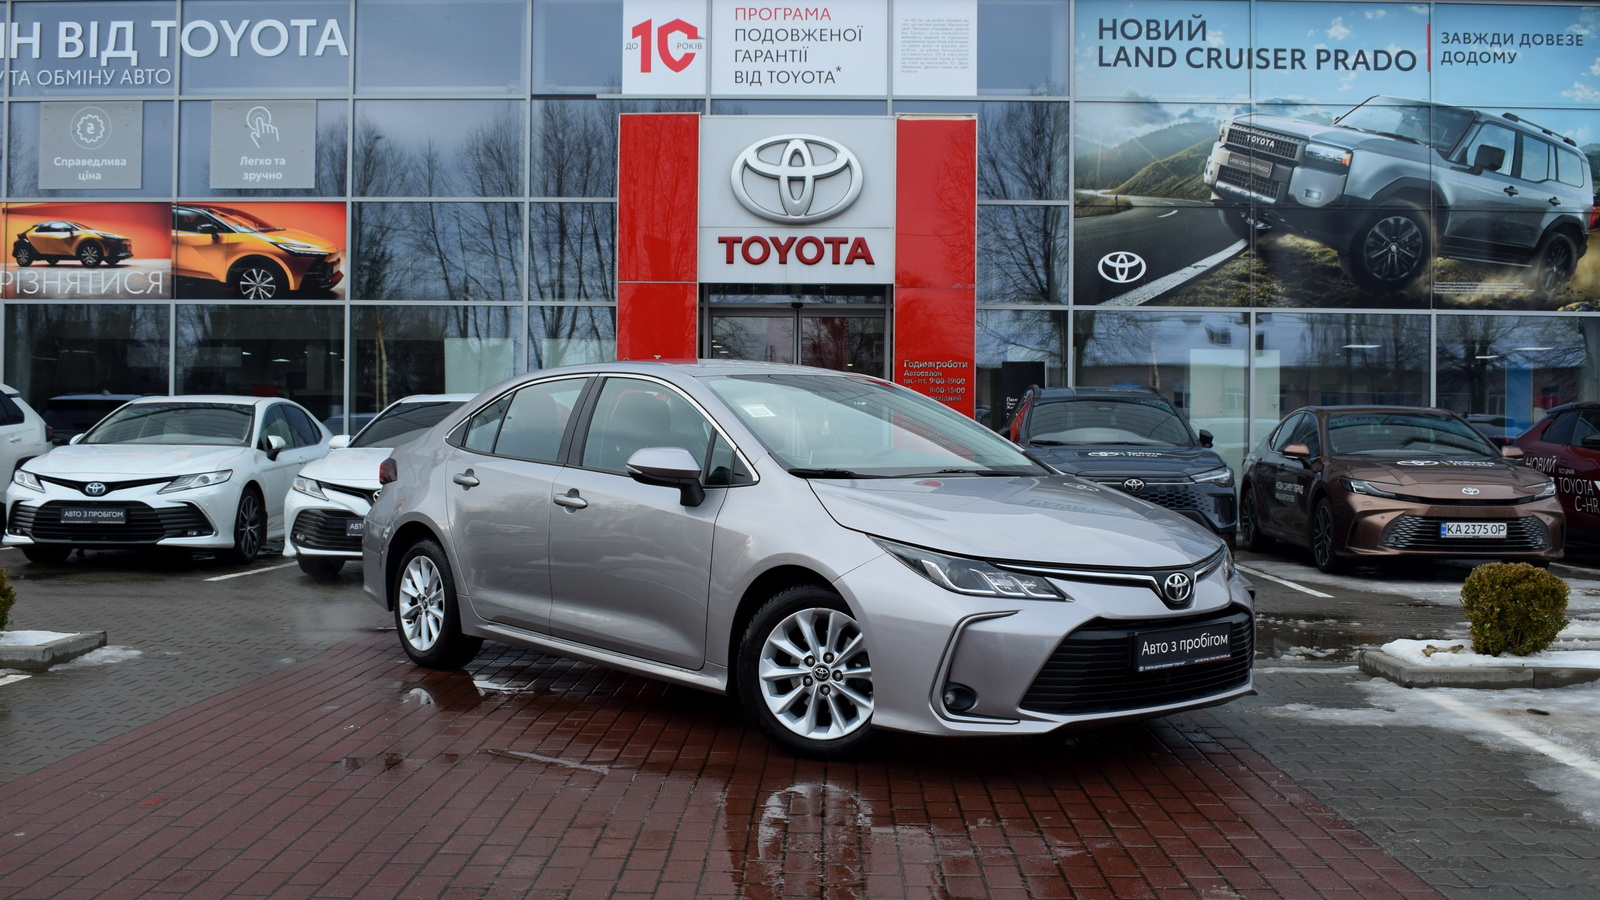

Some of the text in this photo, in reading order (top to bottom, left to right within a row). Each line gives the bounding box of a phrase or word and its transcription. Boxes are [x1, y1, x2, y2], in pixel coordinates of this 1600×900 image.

[735, 8, 831, 21] ПРОГРАМА
[735, 26, 862, 44] ПОДОВЖЕНОЇ
[1098, 14, 1207, 41] НОВИЙ
[58, 21, 138, 66] ВІД
[151, 19, 348, 58] TOYOTA
[625, 42, 639, 51] ДО
[676, 42, 703, 50] РОКІВ
[1441, 32, 1584, 48] ЗАВЖДИ ДОВЕЗЕ
[735, 47, 808, 63] ГАРАНТІЇ
[1098, 46, 1417, 72] LAND CRUISER PRADO
[1441, 51, 1517, 66] ДОДОМУ
[10, 70, 31, 86] ТА
[37, 69, 115, 86] ОБМІНУ
[120, 69, 171, 85] АВТО
[735, 70, 762, 86] ВІД
[1247, 134, 1275, 148] TOYOTA
[53, 156, 127, 168] Справедлива
[239, 156, 286, 166] Легко та
[78, 171, 102, 182] ціна
[243, 171, 283, 182] зручно
[718, 236, 875, 265] TOYOTA
[0, 271, 162, 294] РІЗНЯТИСЯ
[903, 360, 968, 369] Години роботи
[1558, 477, 1594, 496] TOYOTA
[1574, 496, 1600, 514] C-HR
[1447, 524, 1506, 535] KA 2375 OP
[1141, 633, 1228, 656] Авто з пробігом
